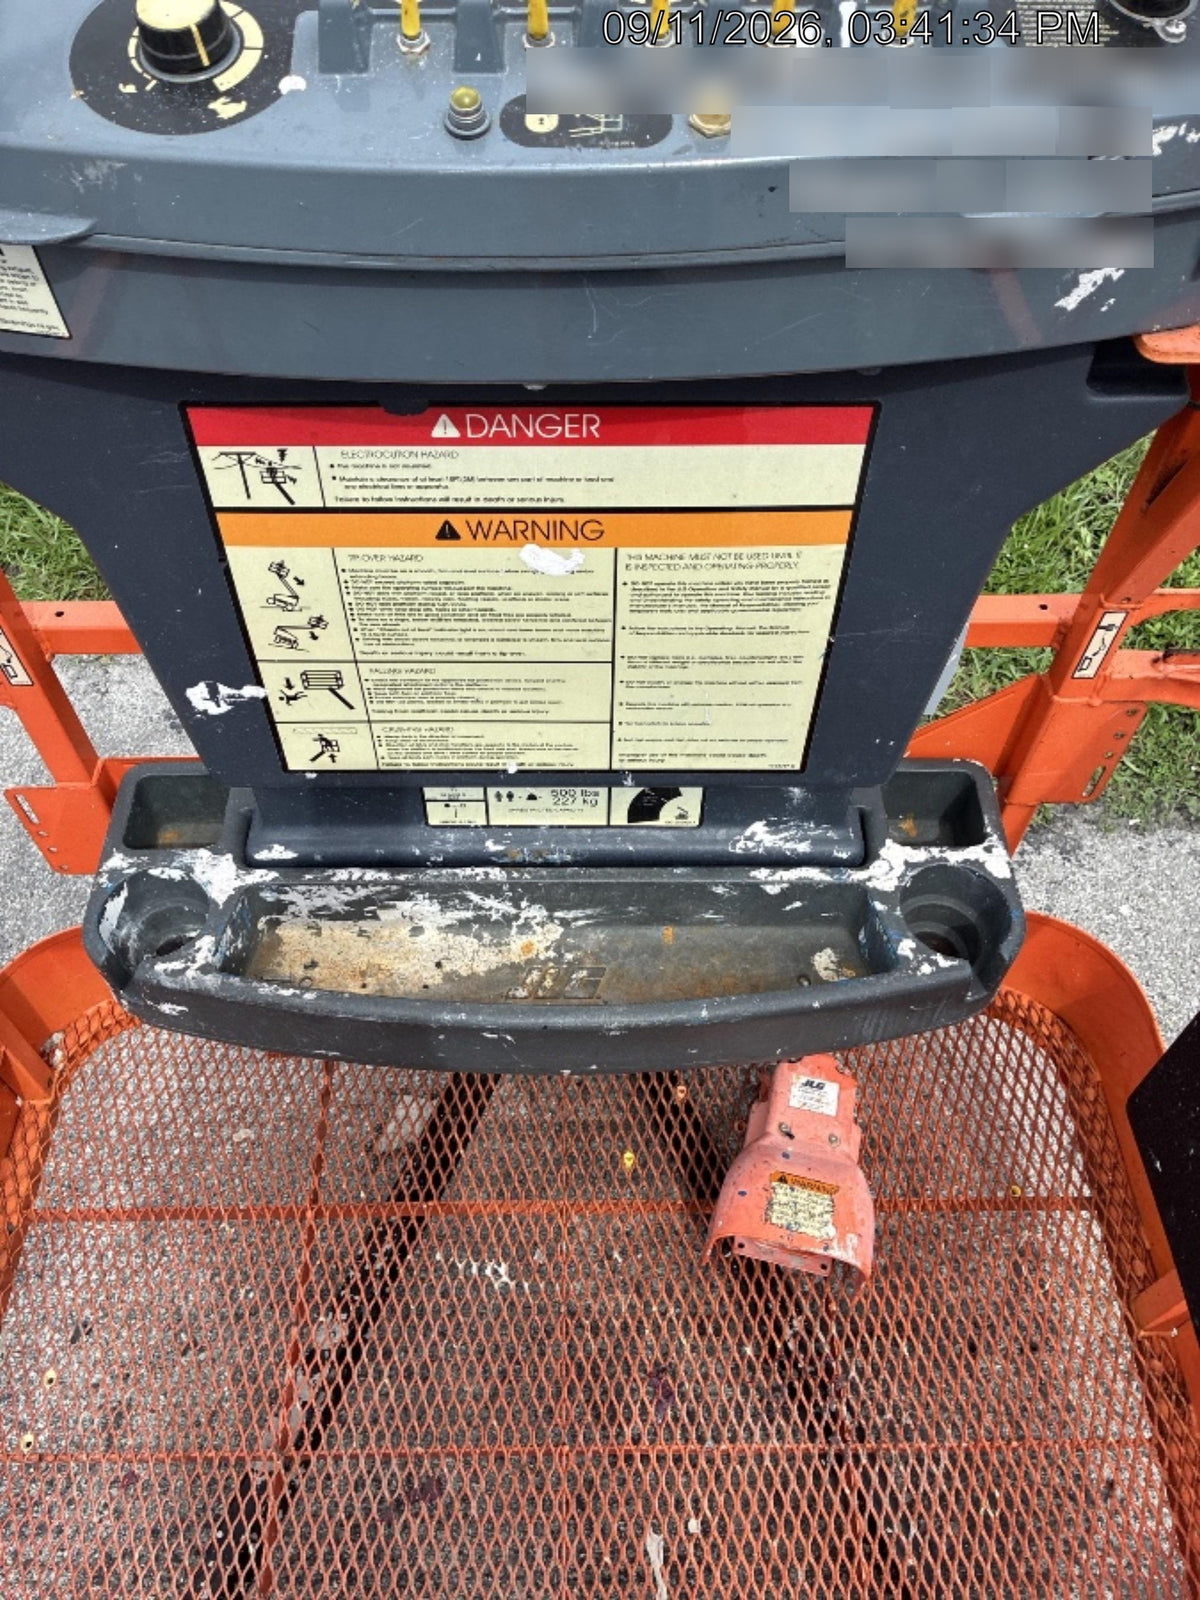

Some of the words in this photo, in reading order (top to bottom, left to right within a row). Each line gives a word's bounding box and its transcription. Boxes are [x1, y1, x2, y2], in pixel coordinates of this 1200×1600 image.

[465, 413, 601, 438] DANGER
[420, 449, 460, 460] HAZARD
[465, 519, 604, 541] WARNING
[645, 553, 685, 561] MACHINE
[714, 552, 732, 560] NOT
[550, 789, 577, 797] 500
[580, 789, 599, 797] lbs
[552, 797, 577, 806] 227
[582, 797, 598, 808] kg
[801, 1079, 826, 1091] JLG
